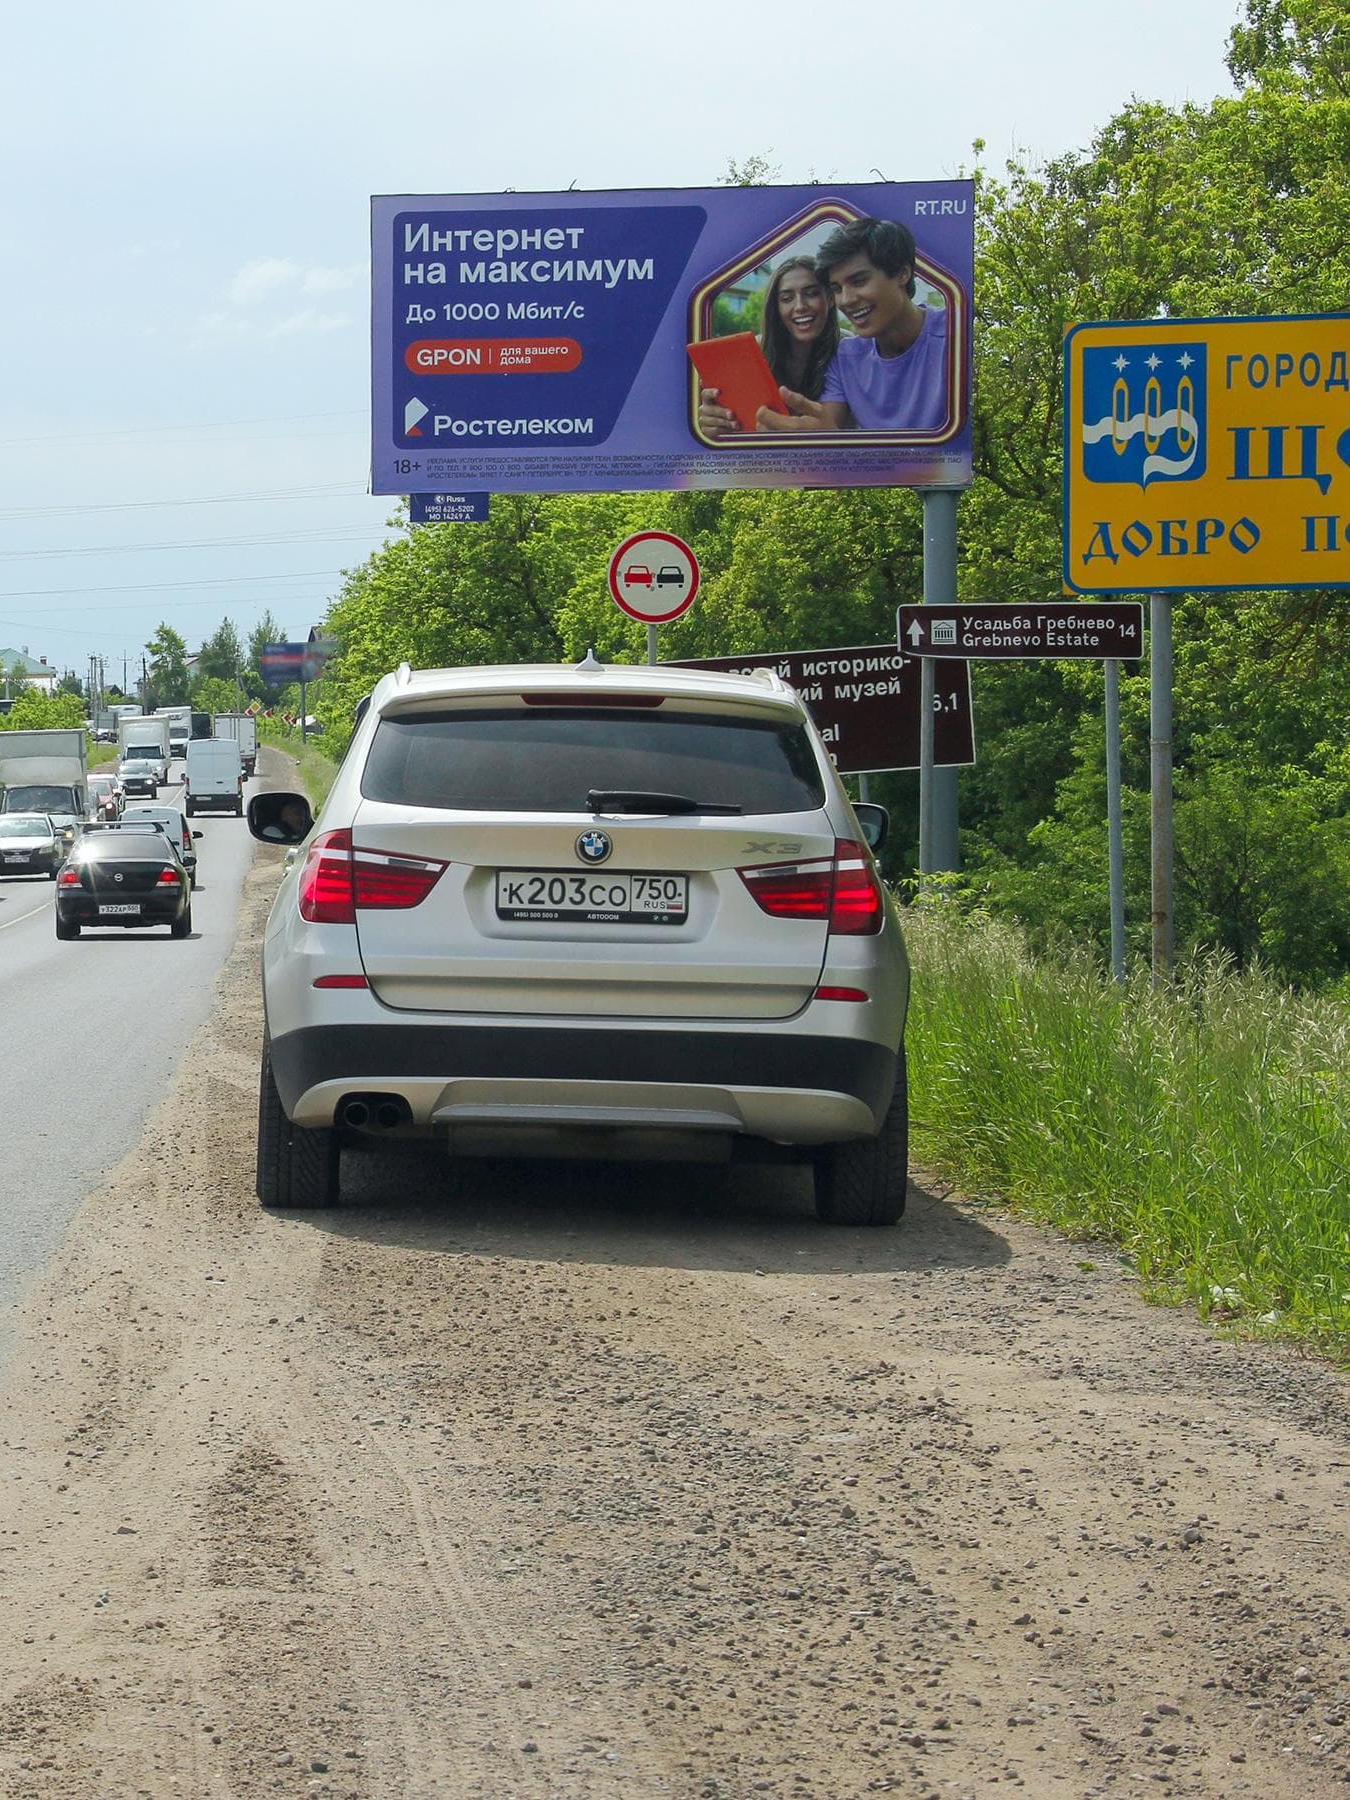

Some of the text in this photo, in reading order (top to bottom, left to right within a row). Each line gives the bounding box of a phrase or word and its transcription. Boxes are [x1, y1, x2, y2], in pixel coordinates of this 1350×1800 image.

[914, 199, 967, 216] RT.RU
[404, 222, 585, 259] Интернет
[403, 257, 654, 289] на максимум
[405, 300, 586, 324] До 1000 Мбит/с
[416, 347, 481, 367] GPON
[499, 345, 569, 358] для вашего
[499, 355, 532, 366] дома
[433, 414, 594, 437] Ростелеком
[393, 458, 422, 475] 18+
[1226, 424, 1350, 496] Щ
[446, 495, 466, 503] Russ
[1082, 515, 1350, 566] ДОБРО П
[962, 615, 1115, 632] Усадьба Гребнево
[1118, 624, 1136, 638] 14
[962, 632, 1100, 647] Grebnevo Estate
[802, 655, 912, 680] историко-
[834, 675, 901, 702] музей
[741, 840, 803, 855] X3
[633, 878, 678, 901] 750
[643, 900, 666, 910] RUS
